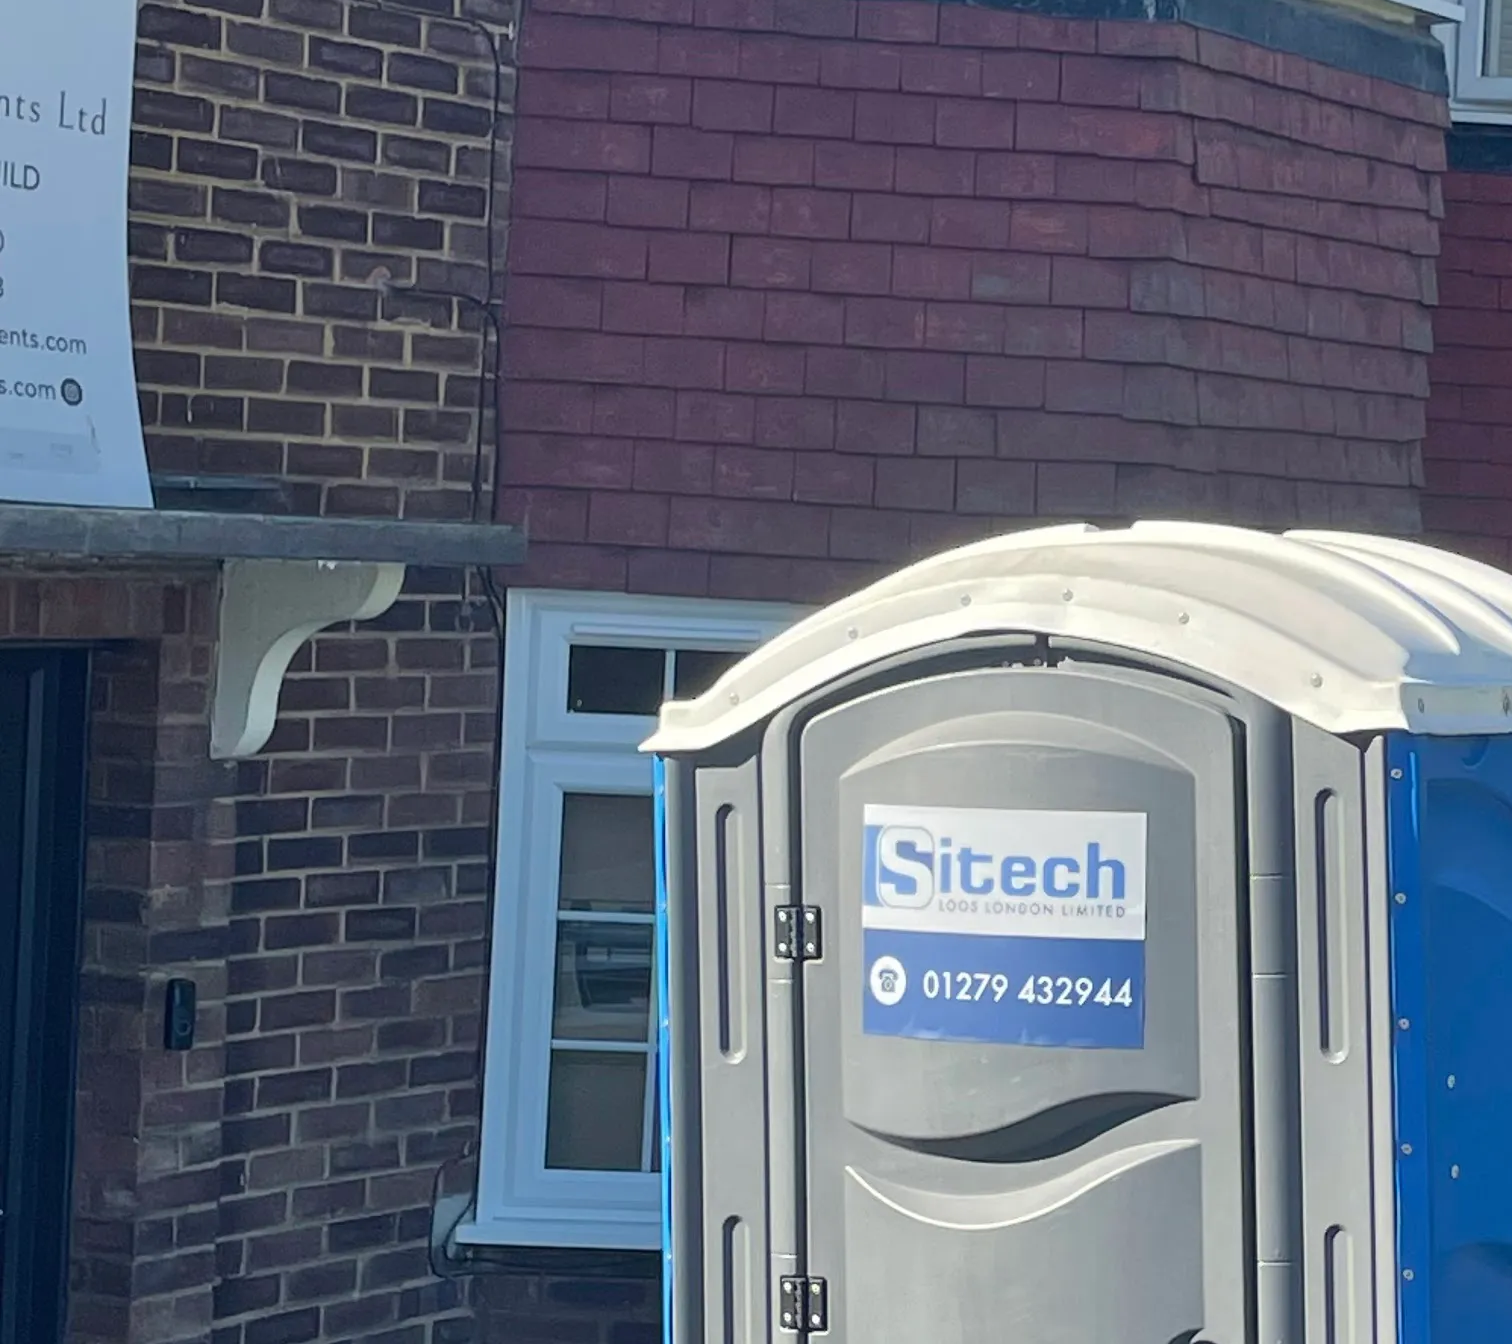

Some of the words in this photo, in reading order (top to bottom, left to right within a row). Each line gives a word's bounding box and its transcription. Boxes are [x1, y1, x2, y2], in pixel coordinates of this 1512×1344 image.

[58, 89, 107, 136] Ltd
[0, 160, 41, 191] ILD
[878, 825, 1126, 909] Sitech
[938, 898, 979, 914] LOOS
[984, 901, 1054, 916] LONDON
[1060, 903, 1126, 918] LIMITED
[922, 969, 1009, 1003] 01279
[1017, 975, 1133, 1008] 432944
